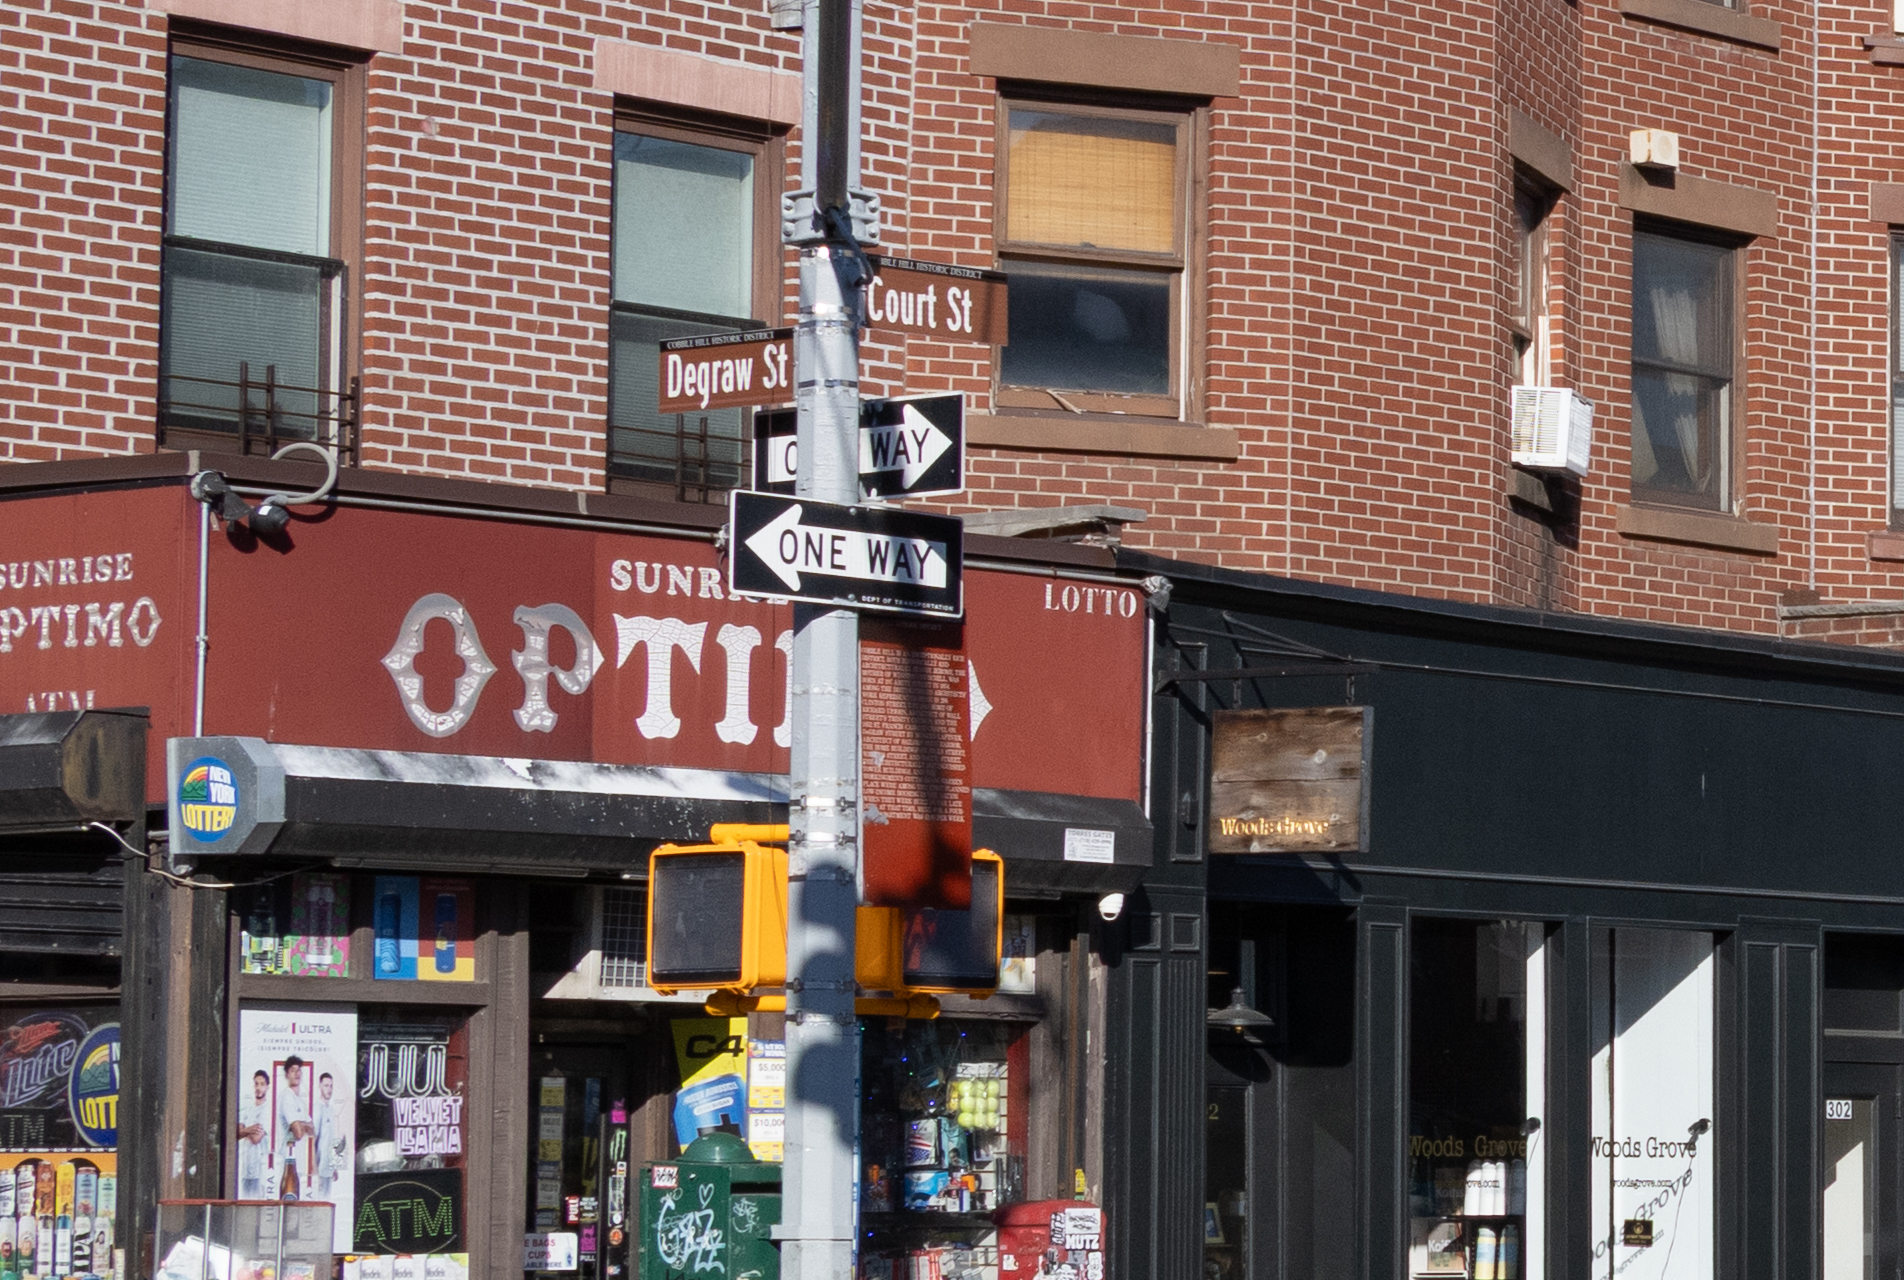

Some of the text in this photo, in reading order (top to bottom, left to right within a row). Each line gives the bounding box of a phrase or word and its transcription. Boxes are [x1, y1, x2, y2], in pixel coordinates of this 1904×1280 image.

[950, 267, 983, 280] DISTRICT
[867, 276, 972, 333] Court St
[667, 331, 775, 350] COBBLE HILL HISTORIC DISTRICT
[667, 343, 788, 410] Degraw St
[870, 428, 930, 468] WAY
[779, 528, 932, 580] ONE WAY
[610, 559, 789, 606] SUNR
[862, 595, 955, 612] DEPT OF TRANSPORTATION
[1045, 583, 1138, 619] LOTTO
[381, 592, 993, 748] OPTI
[209, 765, 231, 785] NEW
[210, 782, 236, 804] YORK
[181, 803, 237, 832] LOTTERY
[1220, 817, 1274, 836] Woods
[299, 1024, 332, 1035] ULTRA
[685, 1035, 744, 1059] C4
[78, 1094, 119, 1129] LOTT
[394, 1097, 463, 1126] VELVET
[1827, 1101, 1851, 1118] 302
[395, 1126, 462, 1156] LLAMA
[1408, 1134, 1528, 1158] Woods Grove
[1591, 1136, 1698, 1158] Woods Grove
[353, 1195, 453, 1243] ATM
[569, 1197, 580, 1222] PULL
[532, 1238, 556, 1248] BAGS
[1065, 1234, 1099, 1250] MUTZ
[528, 1250, 552, 1259] CUPS
[580, 1253, 596, 1263] PULL
